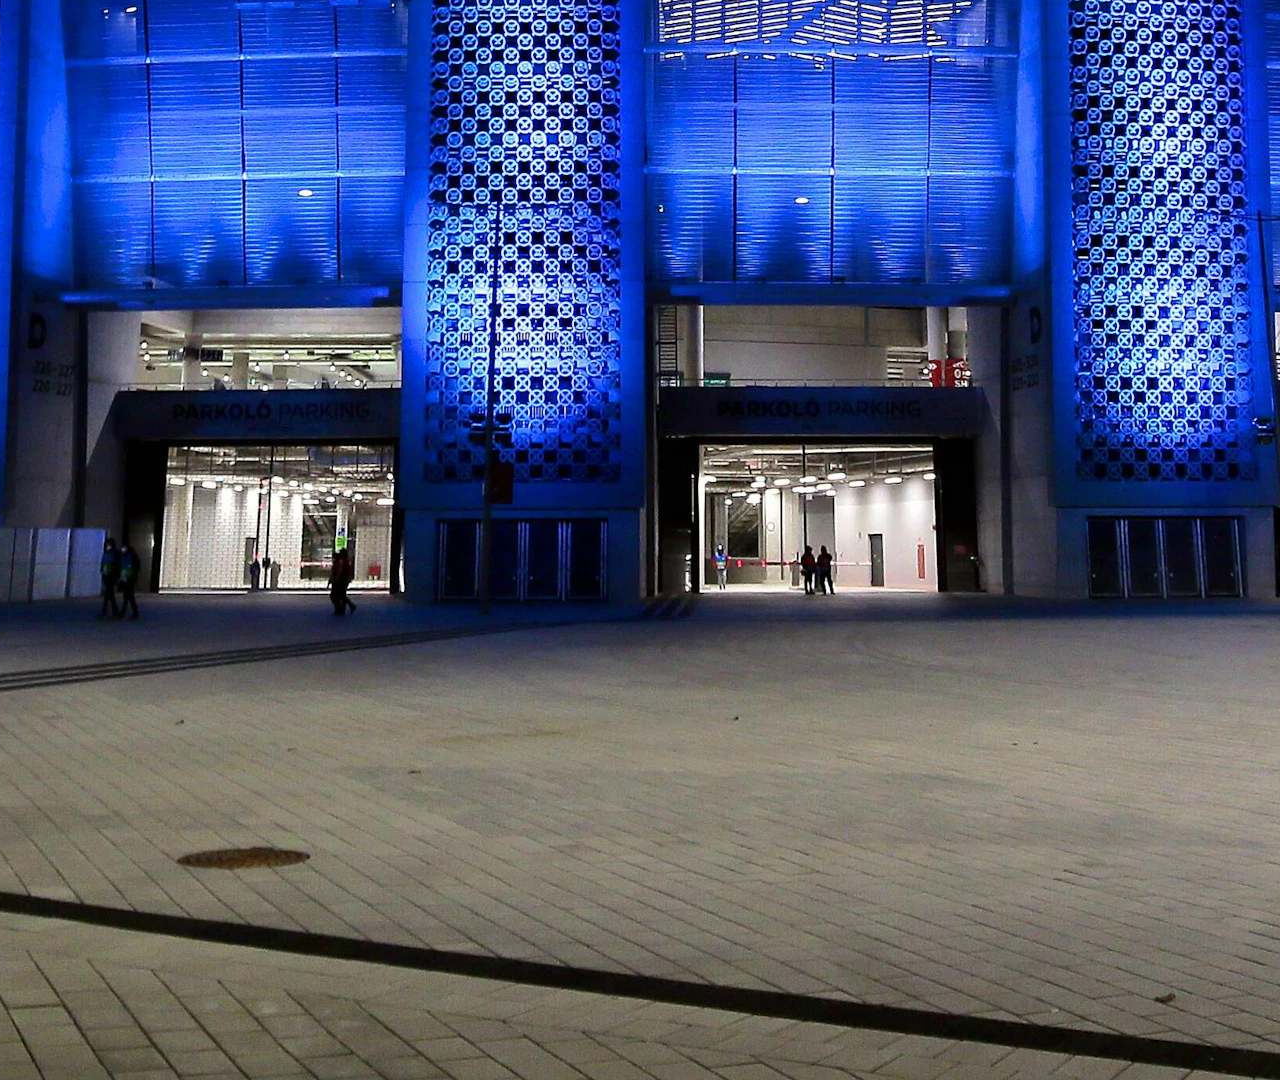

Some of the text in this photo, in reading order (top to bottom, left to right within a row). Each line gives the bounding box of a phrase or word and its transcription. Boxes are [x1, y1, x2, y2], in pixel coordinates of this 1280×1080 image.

[28, 312, 47, 349] D
[173, 397, 371, 420] PARKOLÓ PARKING
[717, 396, 922, 418] PARKOLÓ PARKING
